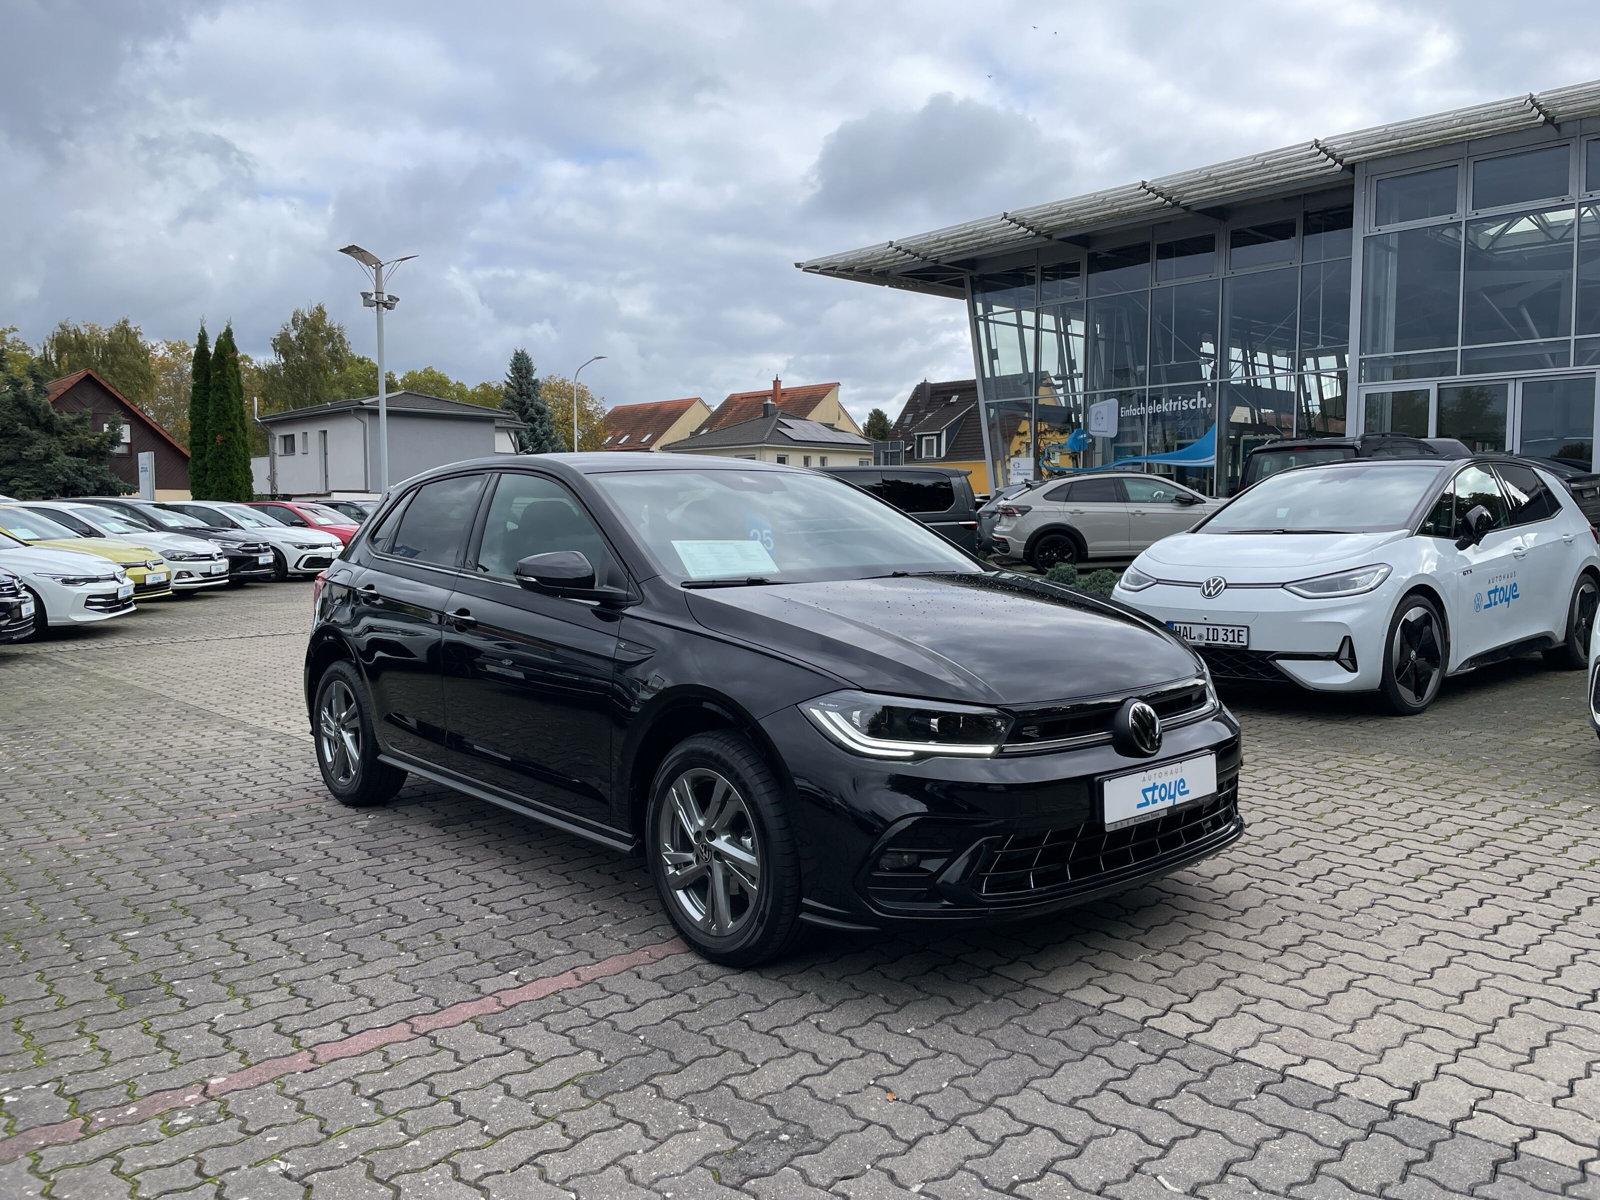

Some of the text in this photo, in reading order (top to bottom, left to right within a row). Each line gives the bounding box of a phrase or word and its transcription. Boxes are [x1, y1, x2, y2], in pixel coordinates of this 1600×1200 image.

[1120, 391, 1212, 417] Einfach elektrisch.
[1141, 766, 1184, 782] AUTOHAUS
